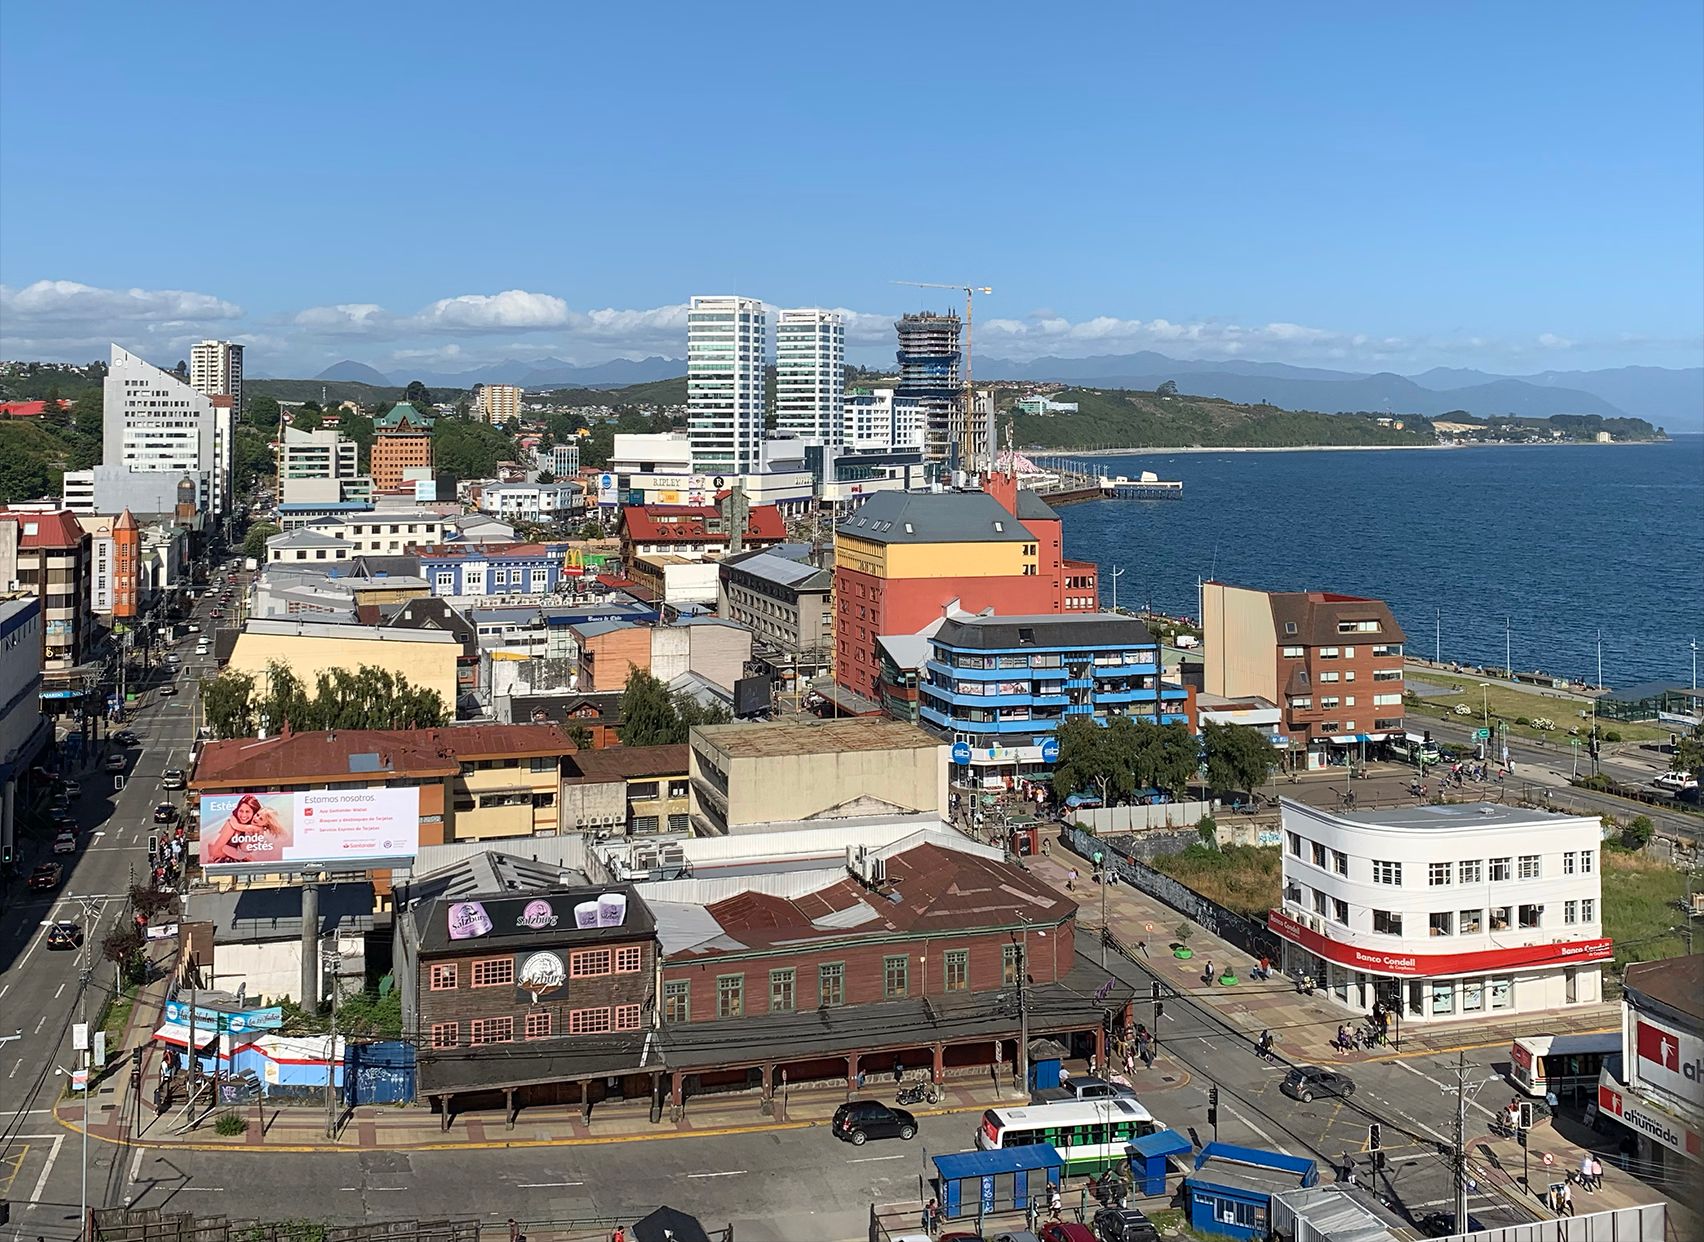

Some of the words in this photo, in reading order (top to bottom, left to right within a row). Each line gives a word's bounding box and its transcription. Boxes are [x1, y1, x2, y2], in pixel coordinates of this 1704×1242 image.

[653, 478, 681, 487] RIPLEY
[954, 748, 970, 757] sb
[1044, 746, 1060, 755] sb
[304, 795, 339, 804] Estamos
[231, 833, 264, 844] donde
[246, 840, 274, 852] estés
[516, 912, 559, 926] Salzburg
[1270, 914, 1284, 927] Banco
[1562, 947, 1584, 955] Banco
[1356, 951, 1382, 964] Banco
[1383, 956, 1416, 966] Condell
[1624, 1109, 1678, 1146] ahumada
